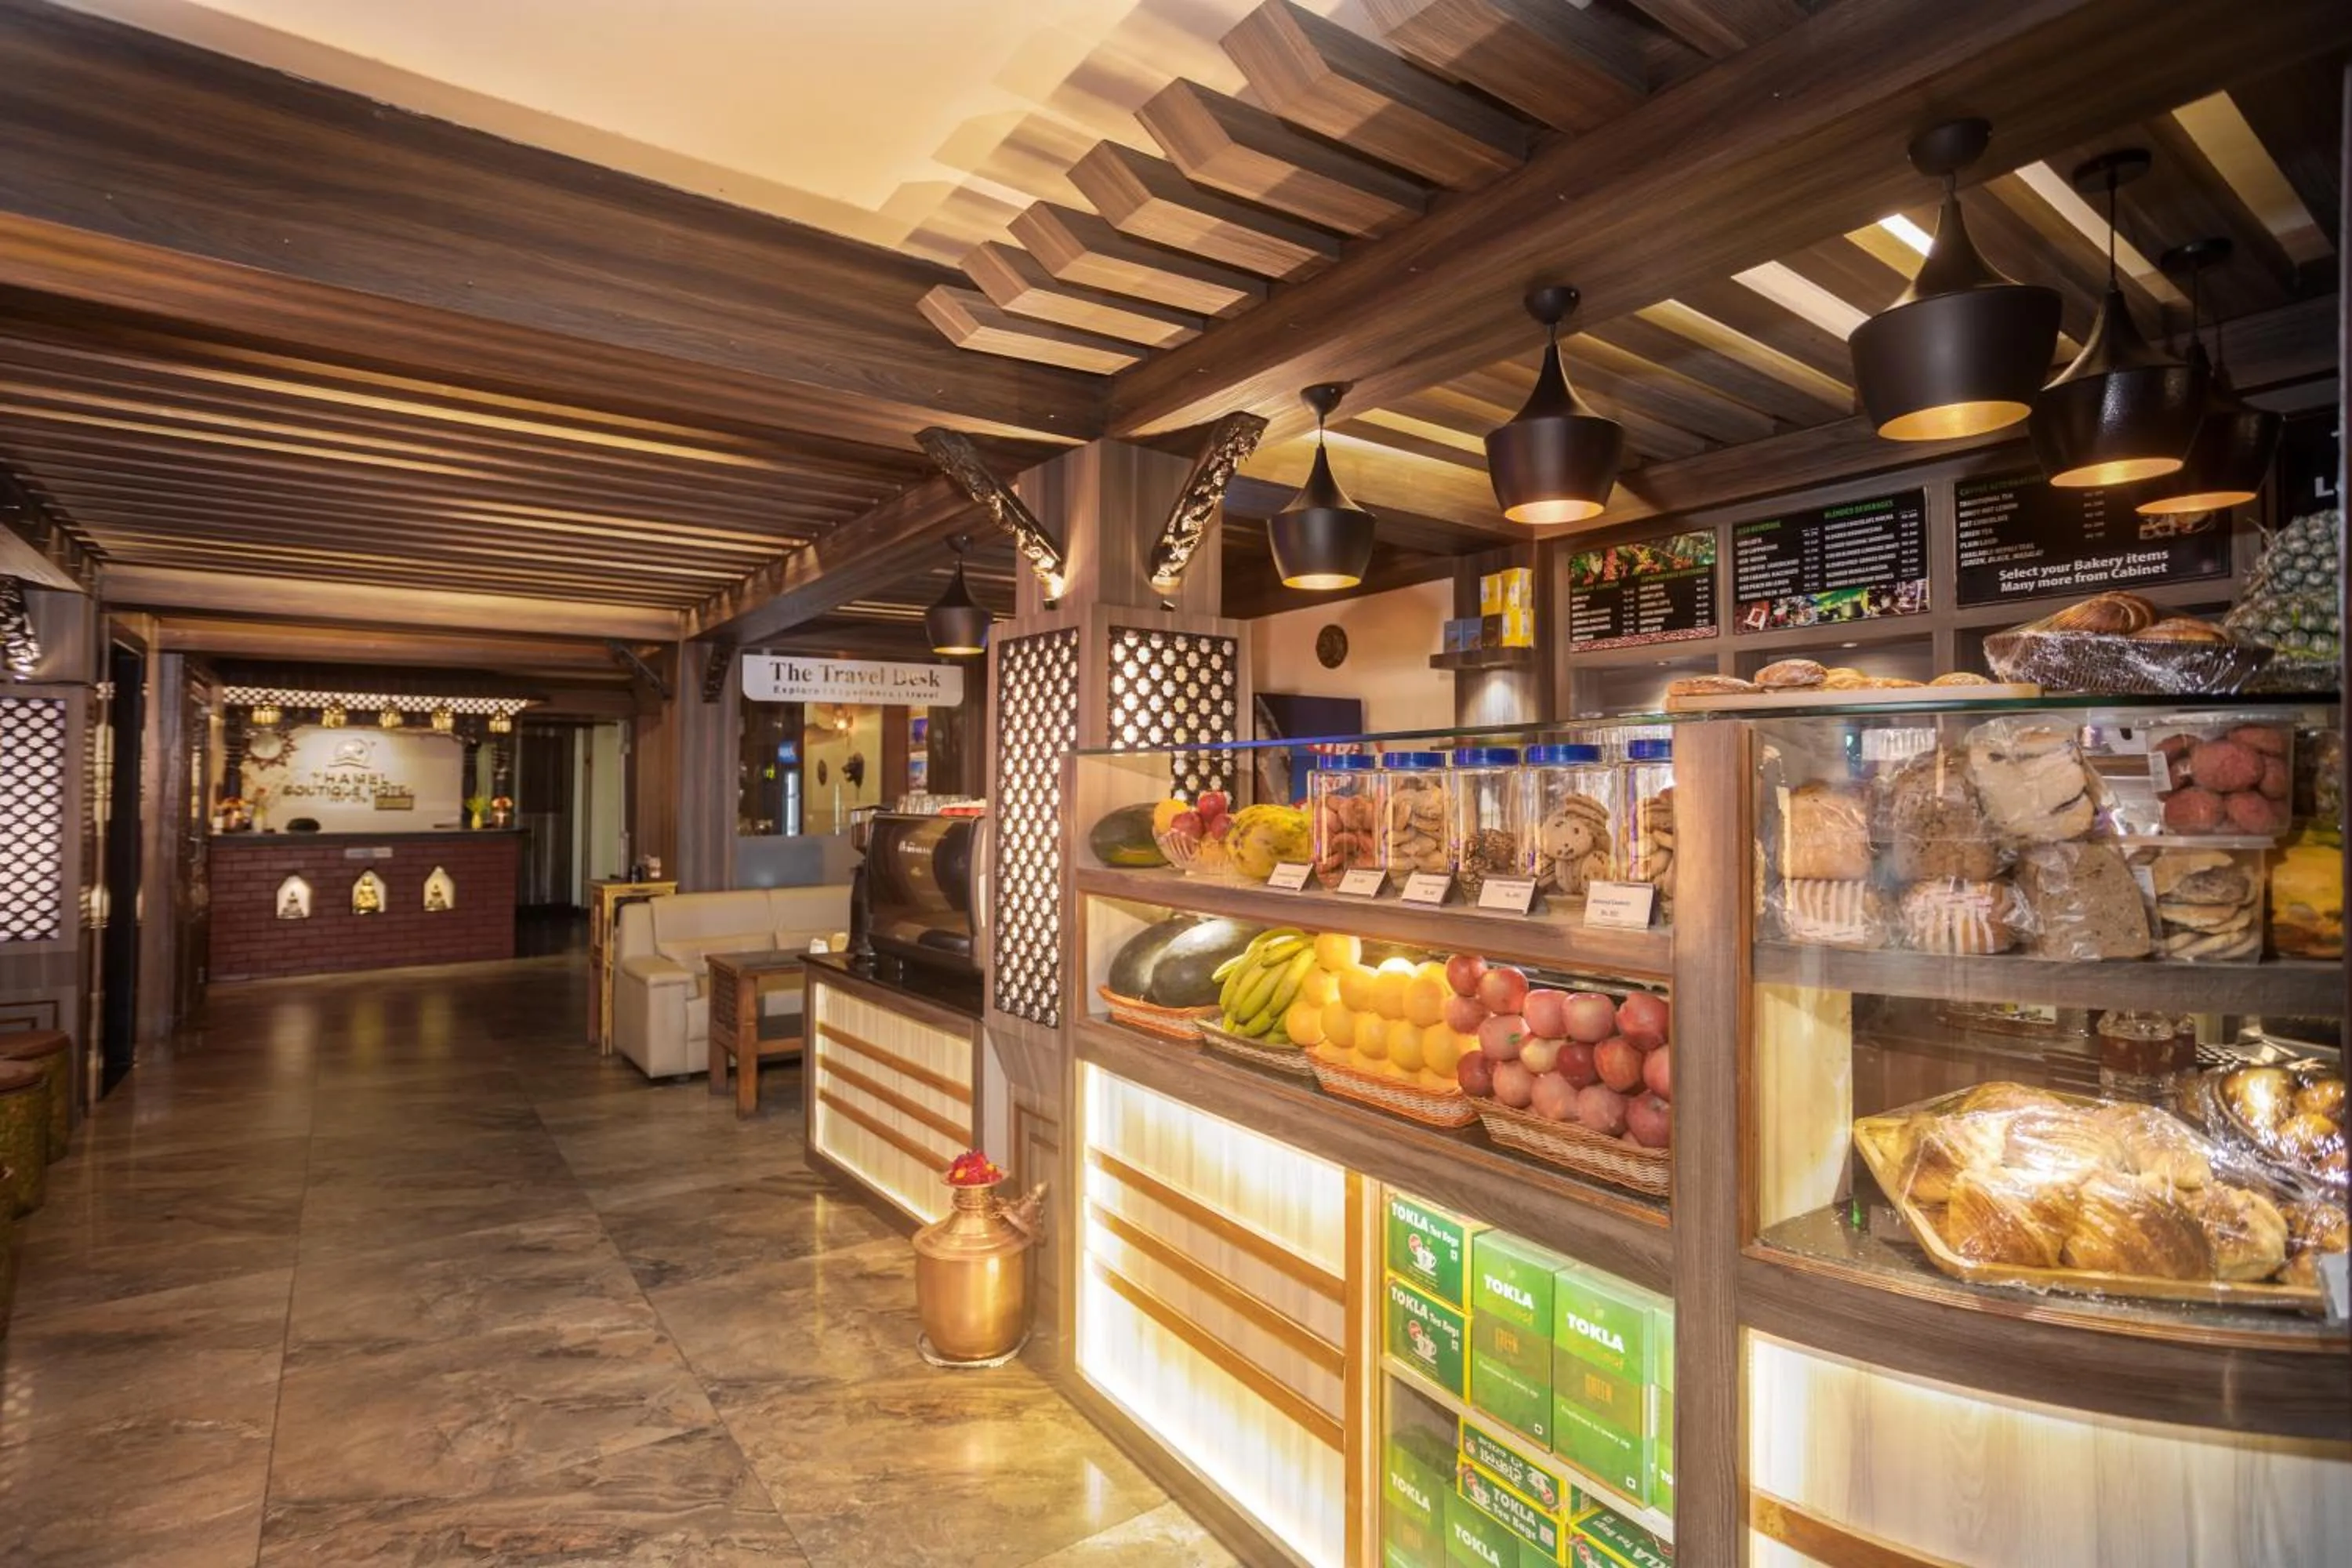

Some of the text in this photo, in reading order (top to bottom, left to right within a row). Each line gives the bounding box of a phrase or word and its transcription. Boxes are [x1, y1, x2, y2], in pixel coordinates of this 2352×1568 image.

[1999, 550, 2169, 581] Select your Bakery items
[2000, 562, 2168, 593] Many more from Cabinet
[769, 662, 941, 688] The Travel Desk
[283, 785, 361, 797] BOUTIQUE
[1392, 1202, 1428, 1232] TOKLA
[1392, 1286, 1428, 1320] TOKLA
[1483, 1273, 1534, 1310] TOKLA
[1566, 1312, 1624, 1354] TOKLA
[1390, 1471, 1432, 1513] TOKLA
[1492, 1488, 1537, 1527] TOKLA
[1492, 1503, 1537, 1541] Tea Bags
[1453, 1523, 1501, 1568] TOKLA
